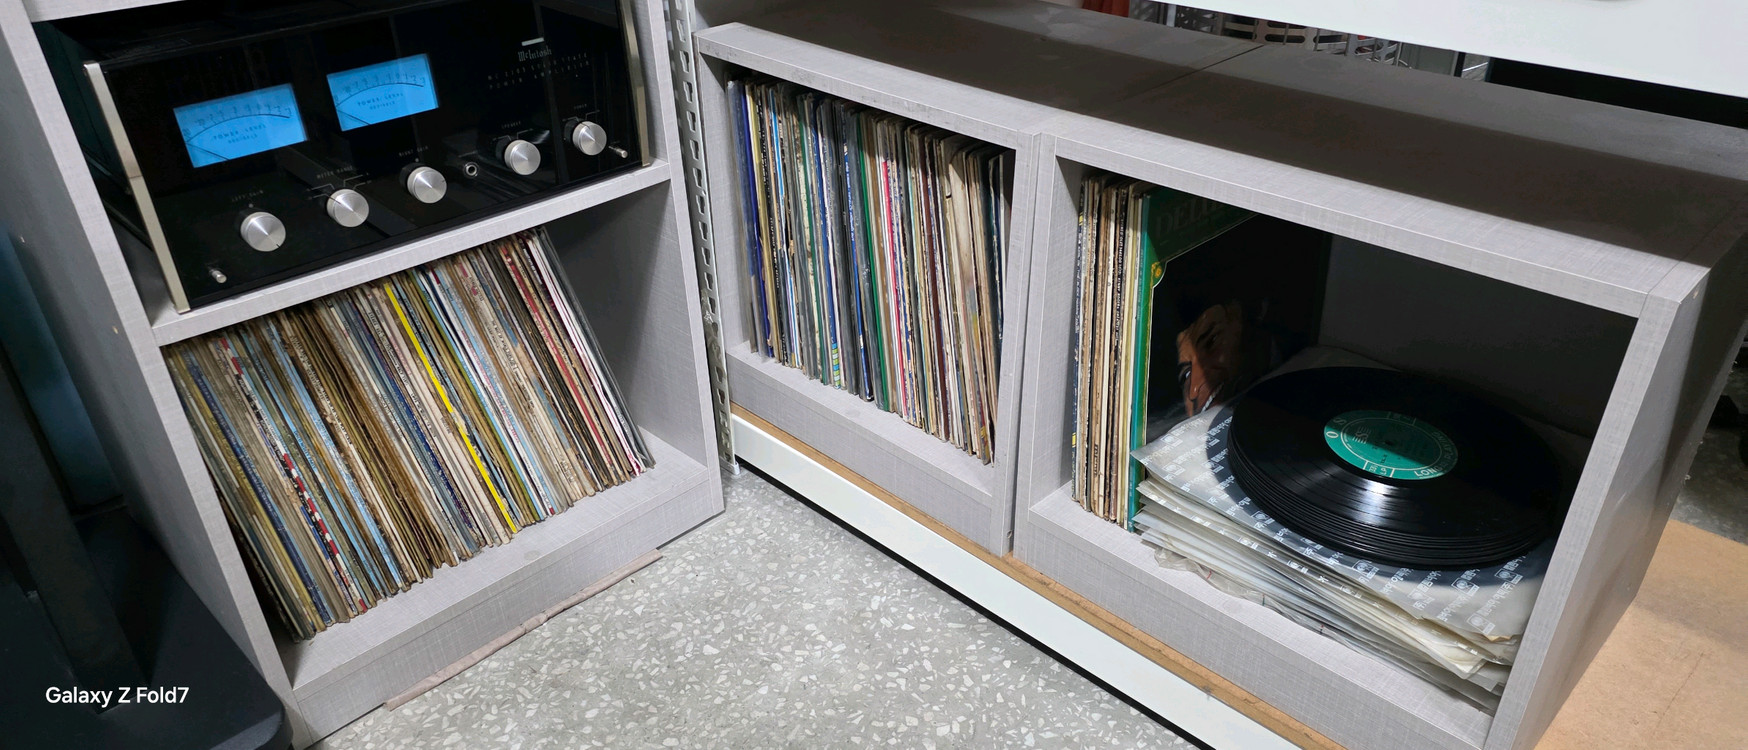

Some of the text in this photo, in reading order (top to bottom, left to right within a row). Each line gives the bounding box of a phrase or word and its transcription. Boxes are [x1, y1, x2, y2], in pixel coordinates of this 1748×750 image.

[357, 97, 379, 106] POWER
[213, 123, 267, 140] POWER LEVEL
[1414, 465, 1443, 477] LONG
